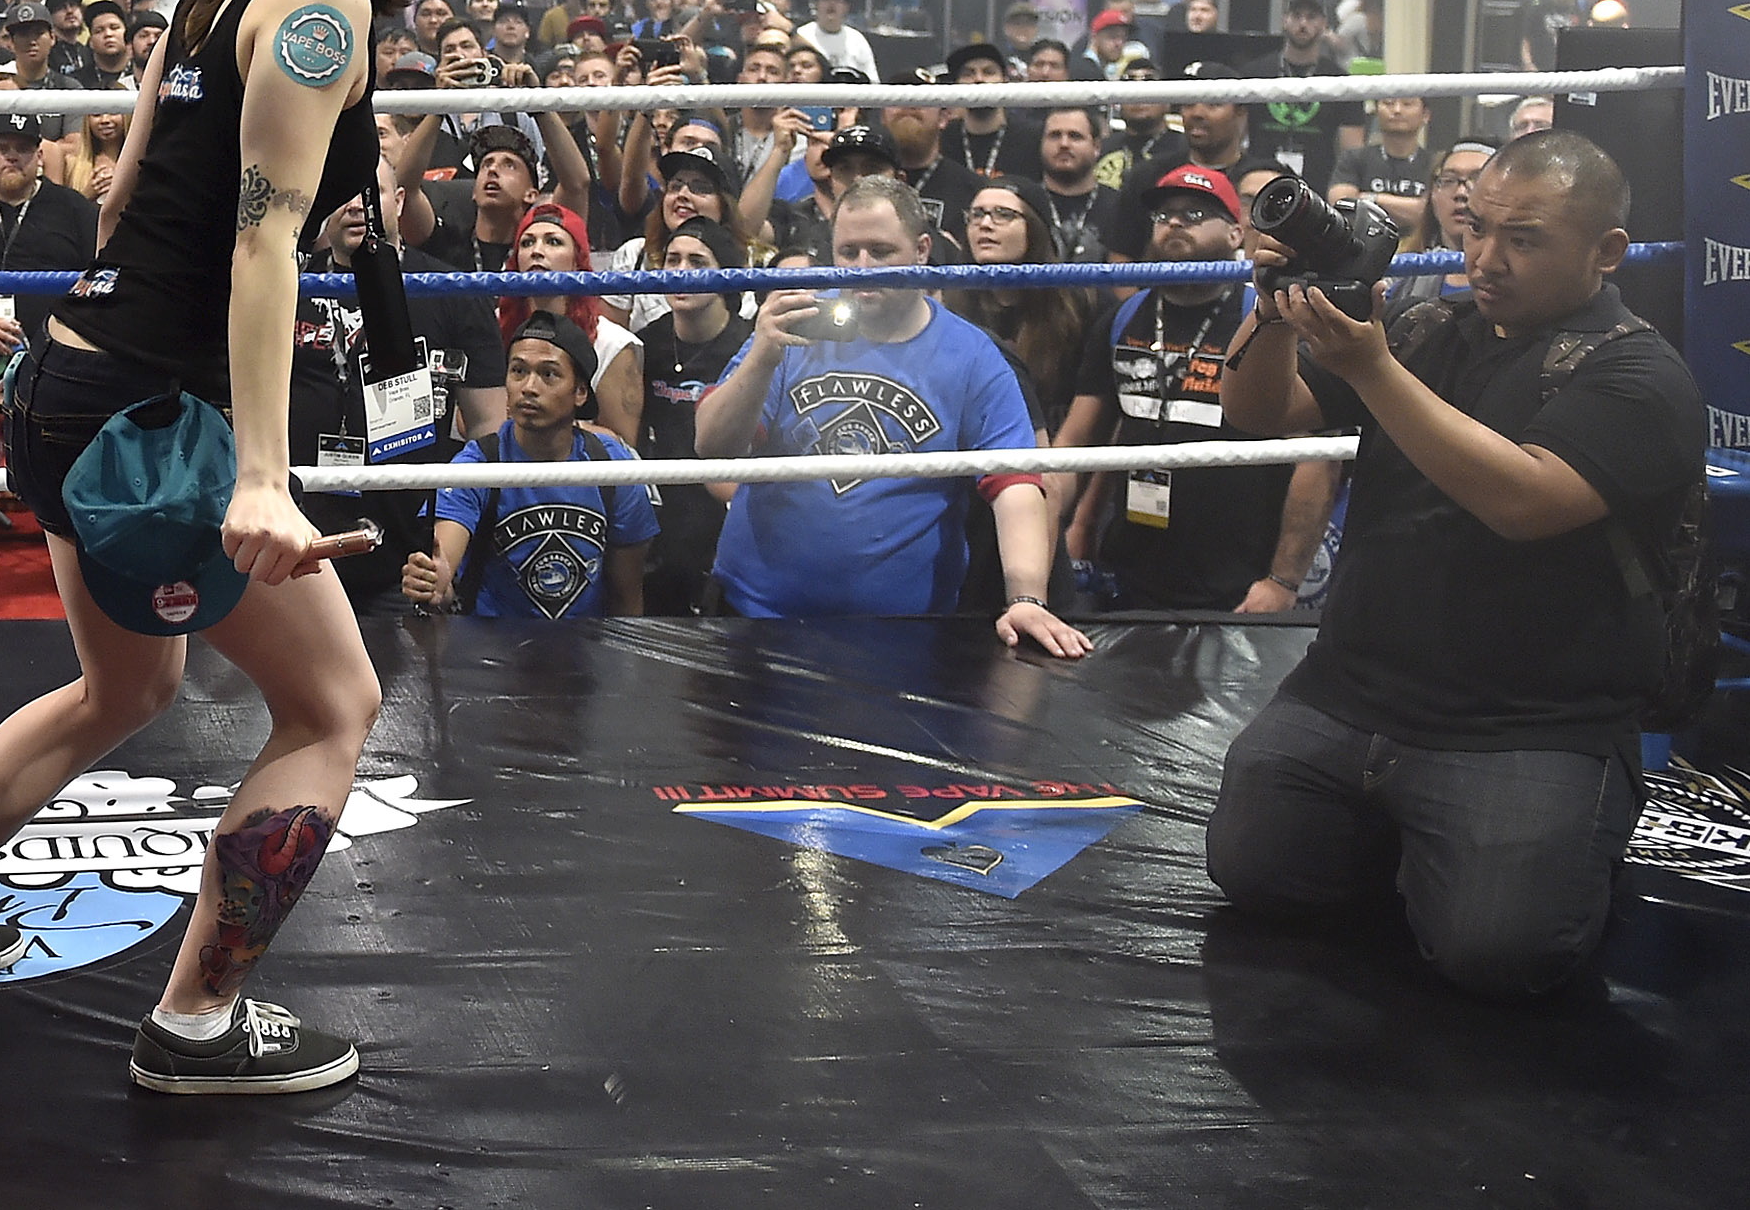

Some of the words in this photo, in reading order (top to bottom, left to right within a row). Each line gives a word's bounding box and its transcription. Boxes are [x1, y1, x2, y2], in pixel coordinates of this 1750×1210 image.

[282, 29, 315, 49] VAPE
[315, 42, 347, 65] BOSS
[1706, 71, 1750, 120] EVE
[377, 380, 394, 392] DEB
[394, 373, 418, 387] STULL
[799, 380, 931, 433] FLAWLESS
[383, 433, 423, 452] EXHIBITOR
[699, 784, 890, 800] SUMMIT
[895, 783, 1027, 799] VAPE
